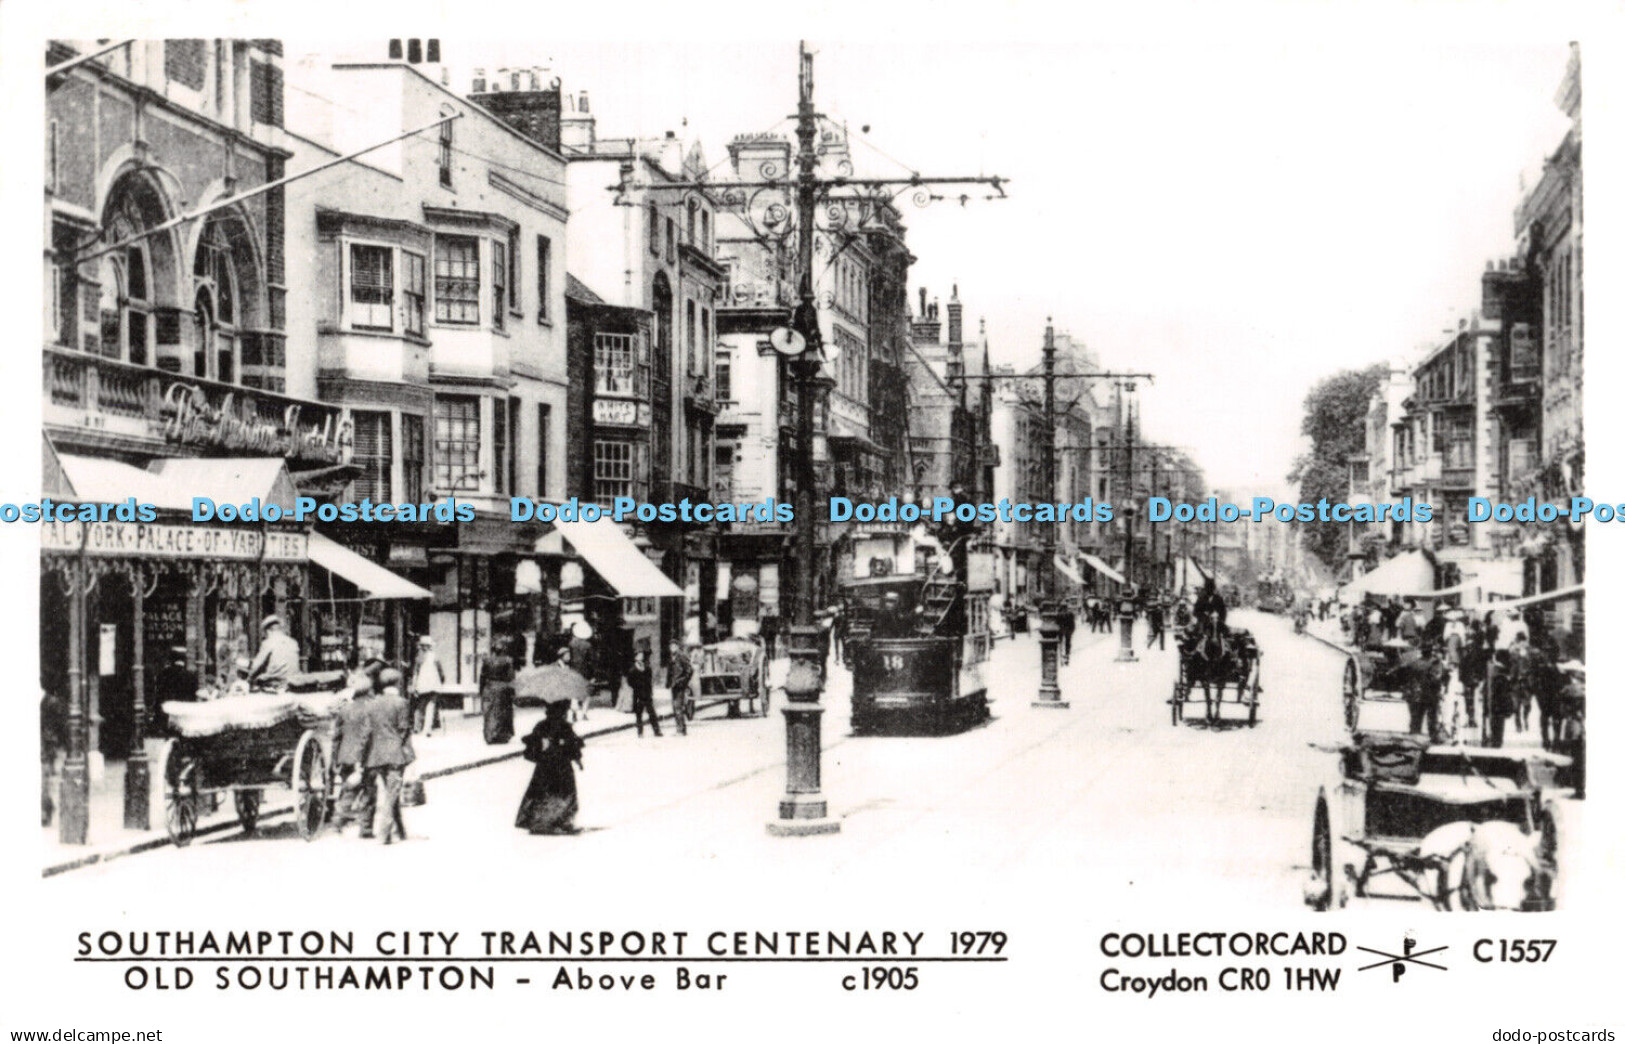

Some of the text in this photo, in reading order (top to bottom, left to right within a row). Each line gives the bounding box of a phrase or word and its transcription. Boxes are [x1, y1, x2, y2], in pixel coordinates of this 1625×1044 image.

[137, 524, 194, 551] PALACE
[204, 530, 222, 552] OF
[231, 530, 300, 557] VARITIES
[883, 655, 904, 670] 18
